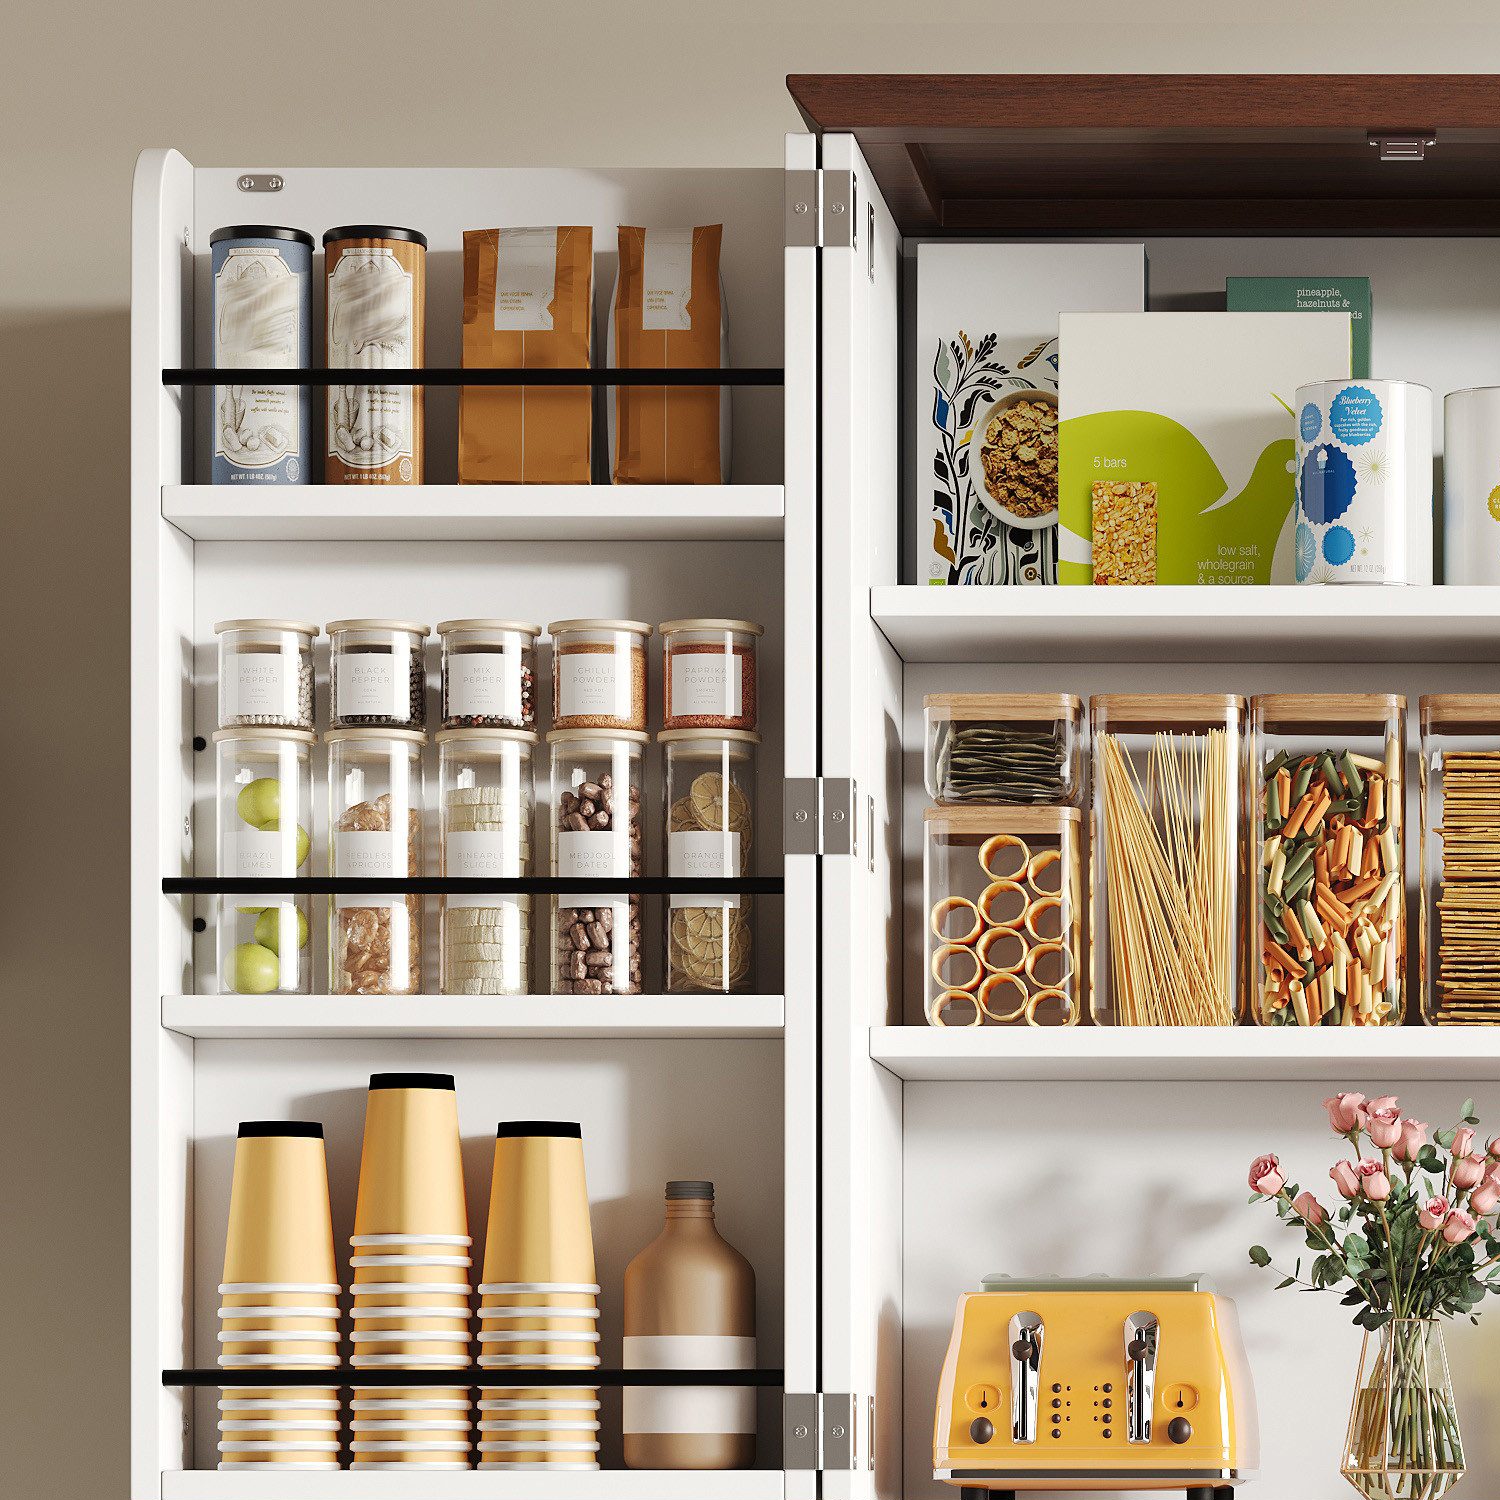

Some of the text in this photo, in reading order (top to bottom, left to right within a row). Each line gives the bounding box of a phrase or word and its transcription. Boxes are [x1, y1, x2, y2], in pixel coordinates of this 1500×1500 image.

[1296, 288, 1342, 298] pineapple,
[1296, 299, 1351, 308] hazelnuts &
[1339, 396, 1373, 407] Blueberry
[1344, 406, 1368, 416] Velvet
[1093, 456, 1127, 468] 5 bars
[1217, 544, 1262, 558] low salt,
[1196, 559, 1255, 573] wholegrain
[1197, 572, 1255, 585] & a source
[684, 666, 727, 674] PAPRIKA
[240, 676, 278, 684] PEPPER
[351, 676, 390, 684] PEPPER
[463, 676, 502, 684] PEPPER
[573, 676, 616, 684] POWDER
[684, 676, 728, 684] POWDER
[239, 852, 275, 860] BRAZIL
[346, 852, 392, 860] SEEDLESS
[569, 852, 616, 860] MEDJOOL
[682, 852, 724, 860] ORANGE
[242, 861, 272, 869] LIMES
[347, 861, 392, 869] APRICOTS
[463, 861, 498, 869] SLICES
[576, 861, 608, 869] DATES
[687, 861, 721, 869] SLICES
